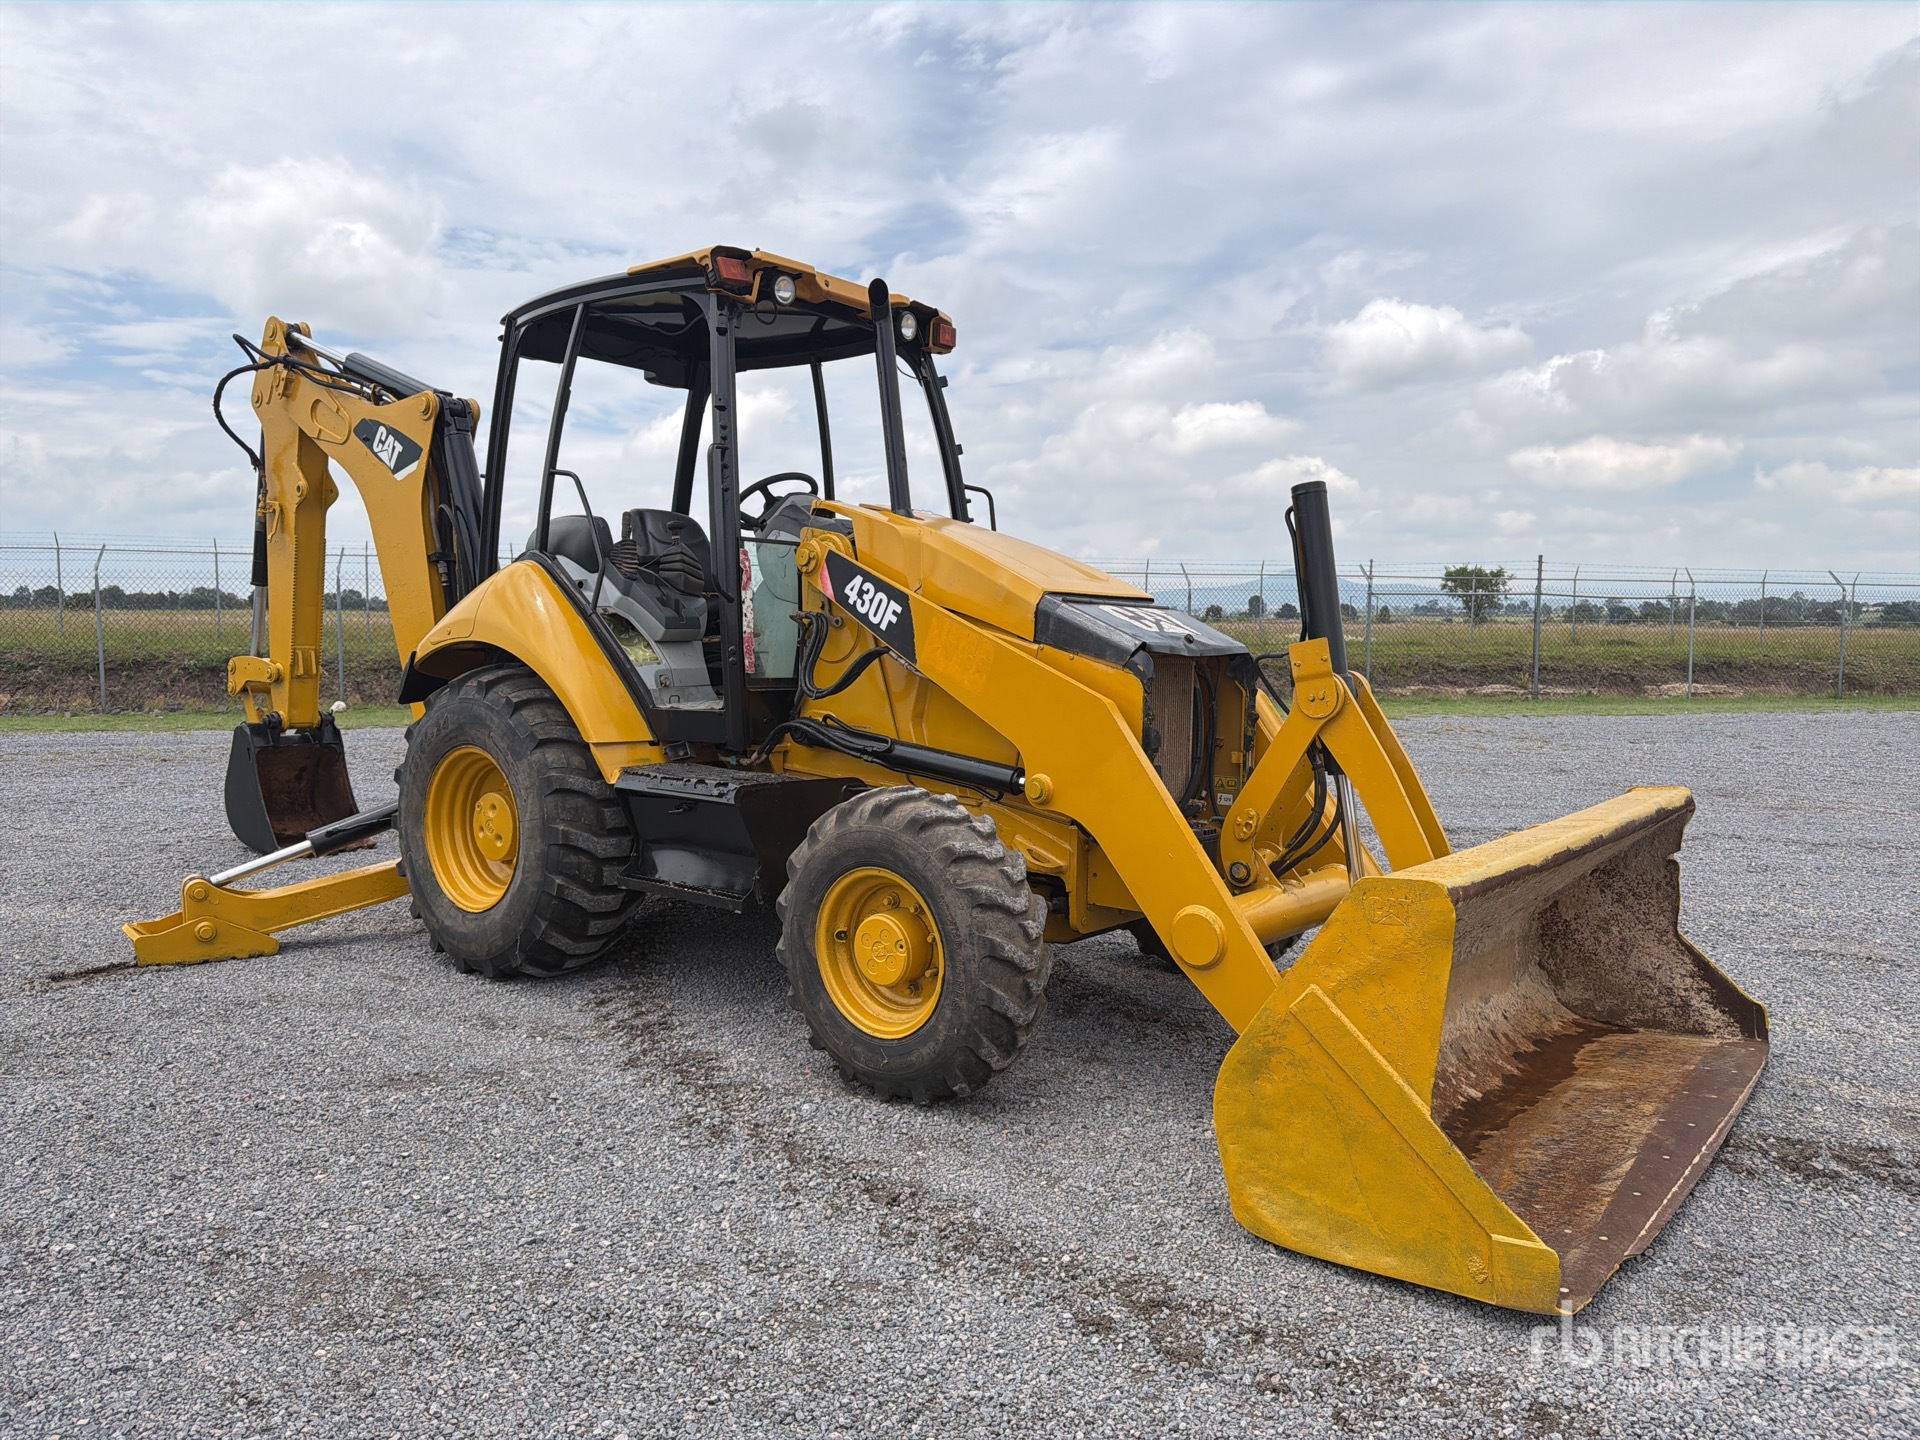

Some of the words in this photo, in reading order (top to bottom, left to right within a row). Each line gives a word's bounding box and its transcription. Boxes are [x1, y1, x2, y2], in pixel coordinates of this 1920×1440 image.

[373, 425, 404, 470] CAT
[843, 574, 903, 632] 430F
[1364, 896, 1412, 927] CAT
